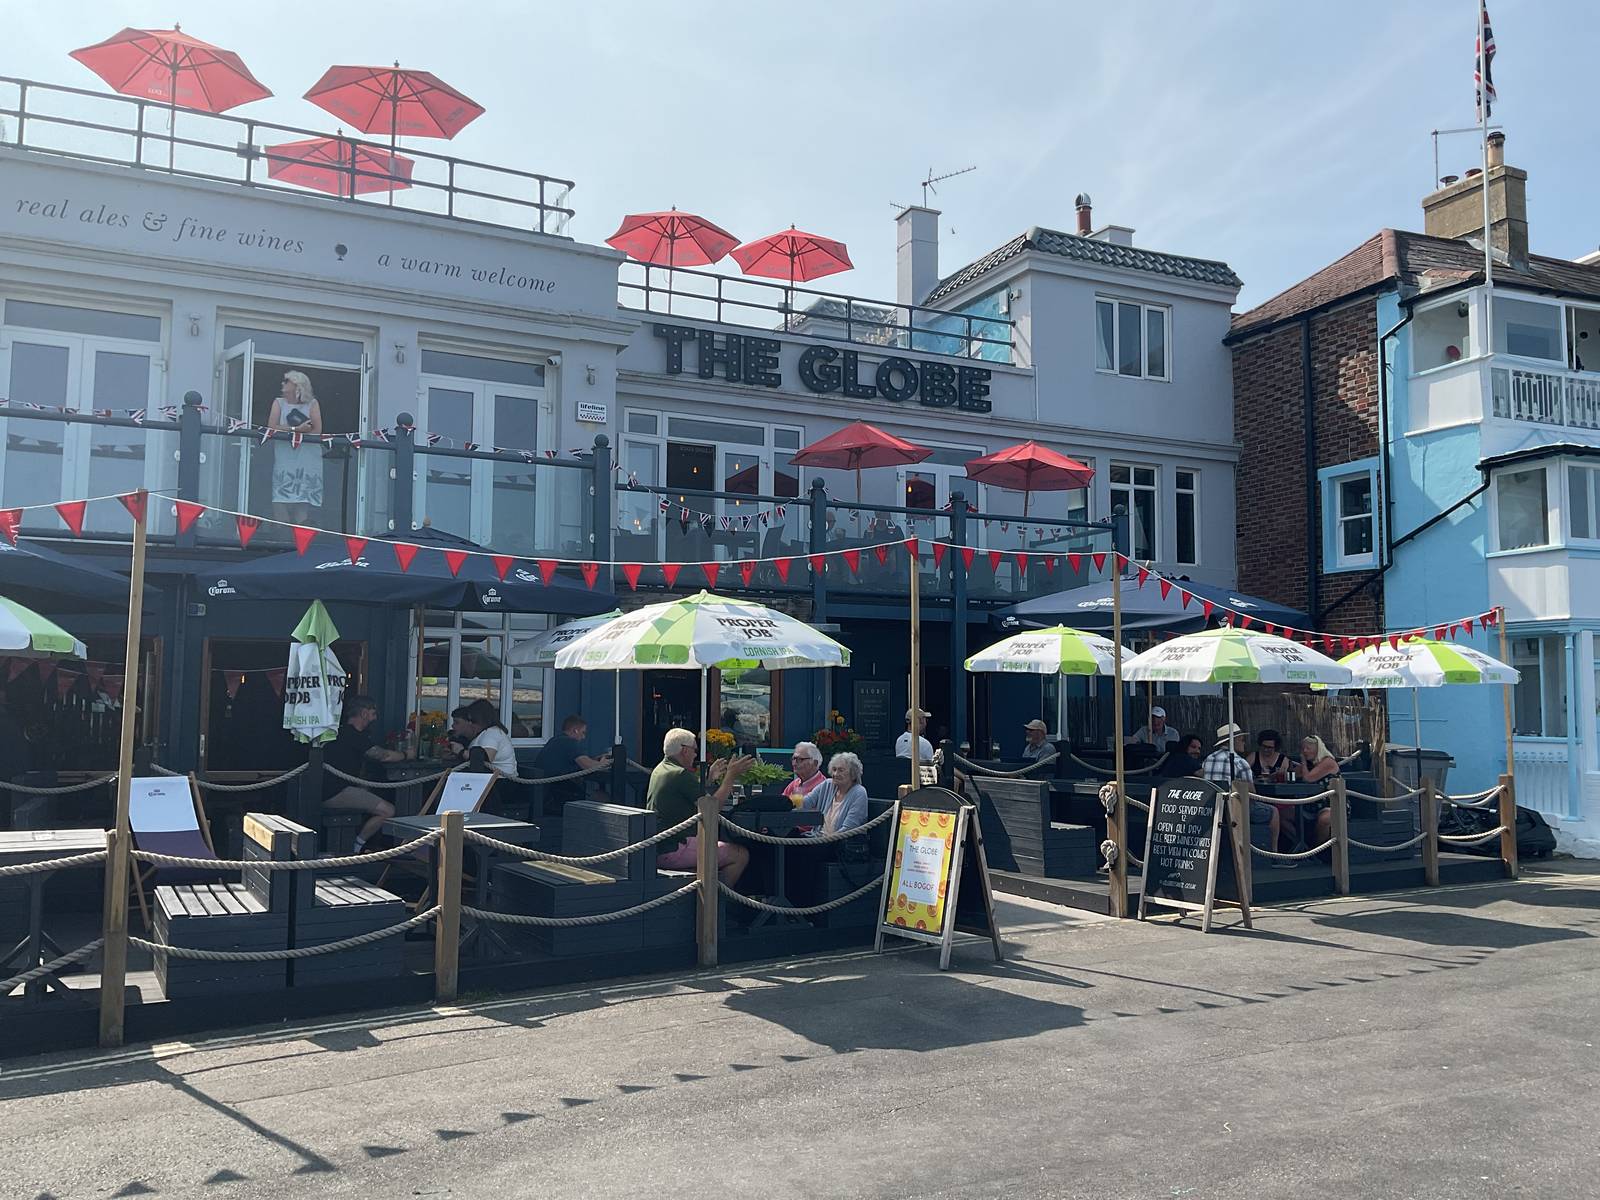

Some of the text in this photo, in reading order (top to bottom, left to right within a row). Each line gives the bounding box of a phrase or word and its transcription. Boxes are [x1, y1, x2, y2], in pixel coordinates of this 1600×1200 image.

[16, 199, 305, 254] real ales & fine wines
[377, 253, 557, 294] a warm welcome
[653, 324, 992, 413] THE GLOBE
[580, 402, 605, 411] lifeline
[717, 618, 779, 628] PROPER
[742, 629, 773, 639] JOB
[744, 647, 778, 656] CORNISH
[1013, 648, 1033, 656] JOB
[1161, 646, 1202, 654] PROPER
[1261, 646, 1302, 655] PROPER
[1162, 653, 1185, 663] JOB
[1282, 653, 1303, 663] JOB
[1368, 655, 1413, 663] PROPER
[1376, 663, 1399, 671] JOB
[308, 715, 321, 725] IPA
[1168, 789, 1204, 801] THE GLOBE
[1161, 804, 1213, 817] FOOD SERVED FROM
[1157, 822, 1202, 835] OPEN ALL DAY
[1164, 834, 1177, 844] BEER
[910, 845, 938, 855] THE GLOBE
[1153, 845, 1167, 855] BEST
[1160, 858, 1194, 870] HOT DRINKS
